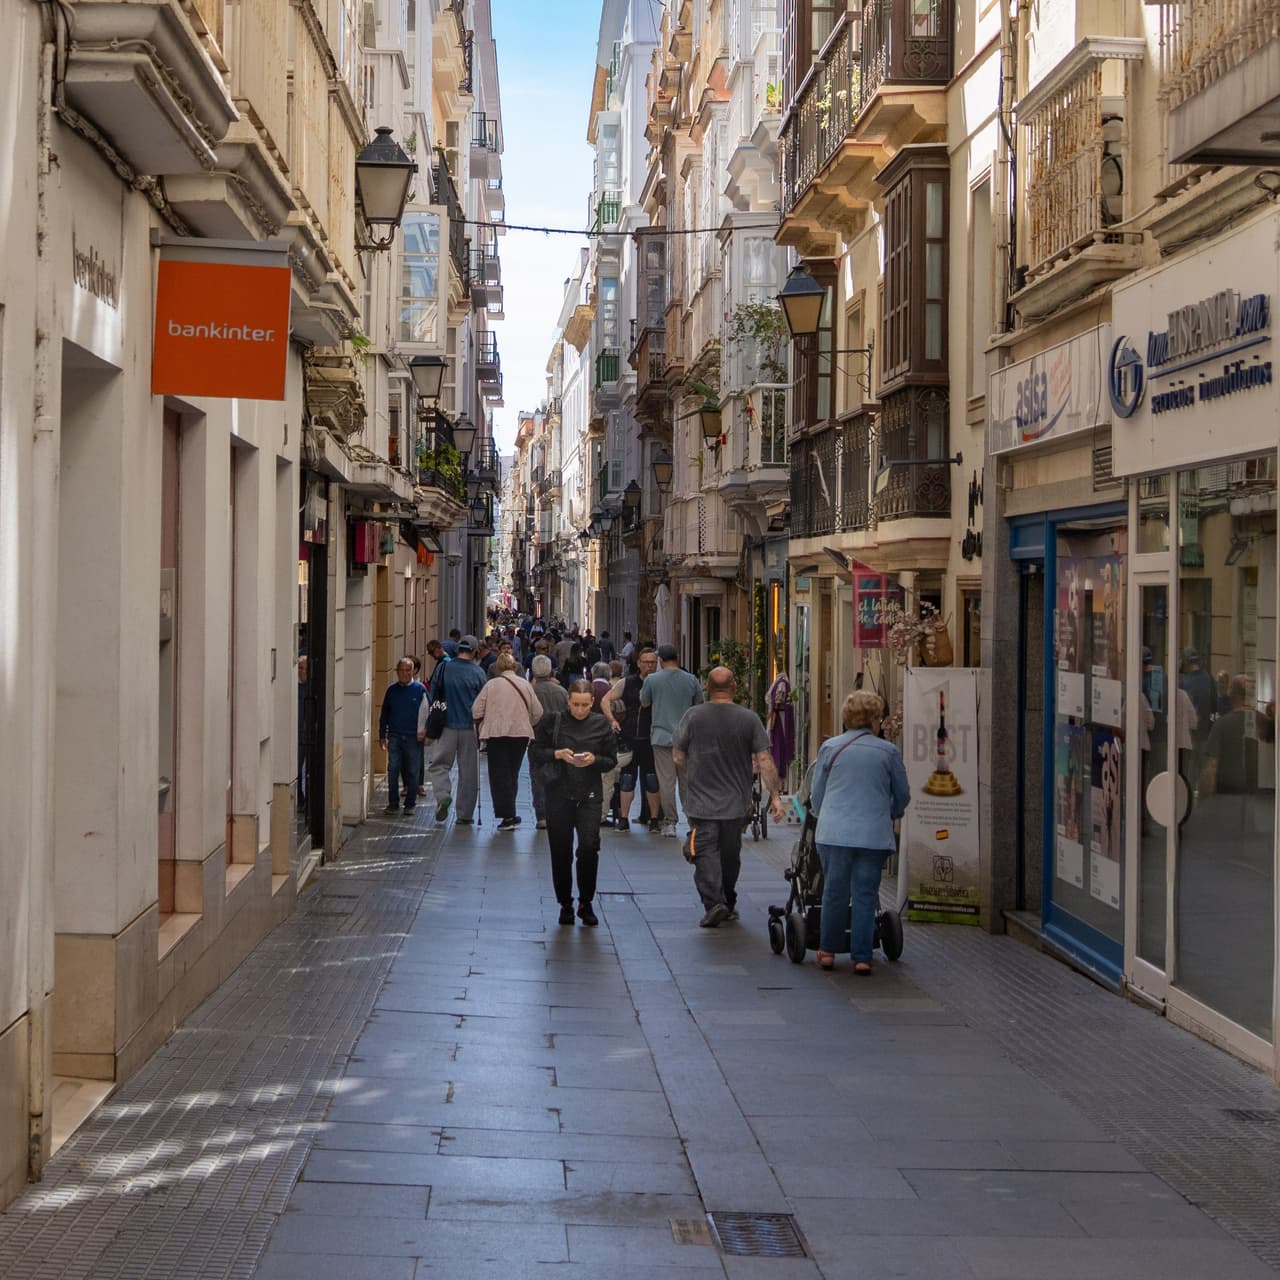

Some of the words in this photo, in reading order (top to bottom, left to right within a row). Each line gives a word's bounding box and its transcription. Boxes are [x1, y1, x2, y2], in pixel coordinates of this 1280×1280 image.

[168, 319, 275, 342] bankinter.
[1016, 370, 1048, 429] asisa
[913, 723, 971, 763] BEST
